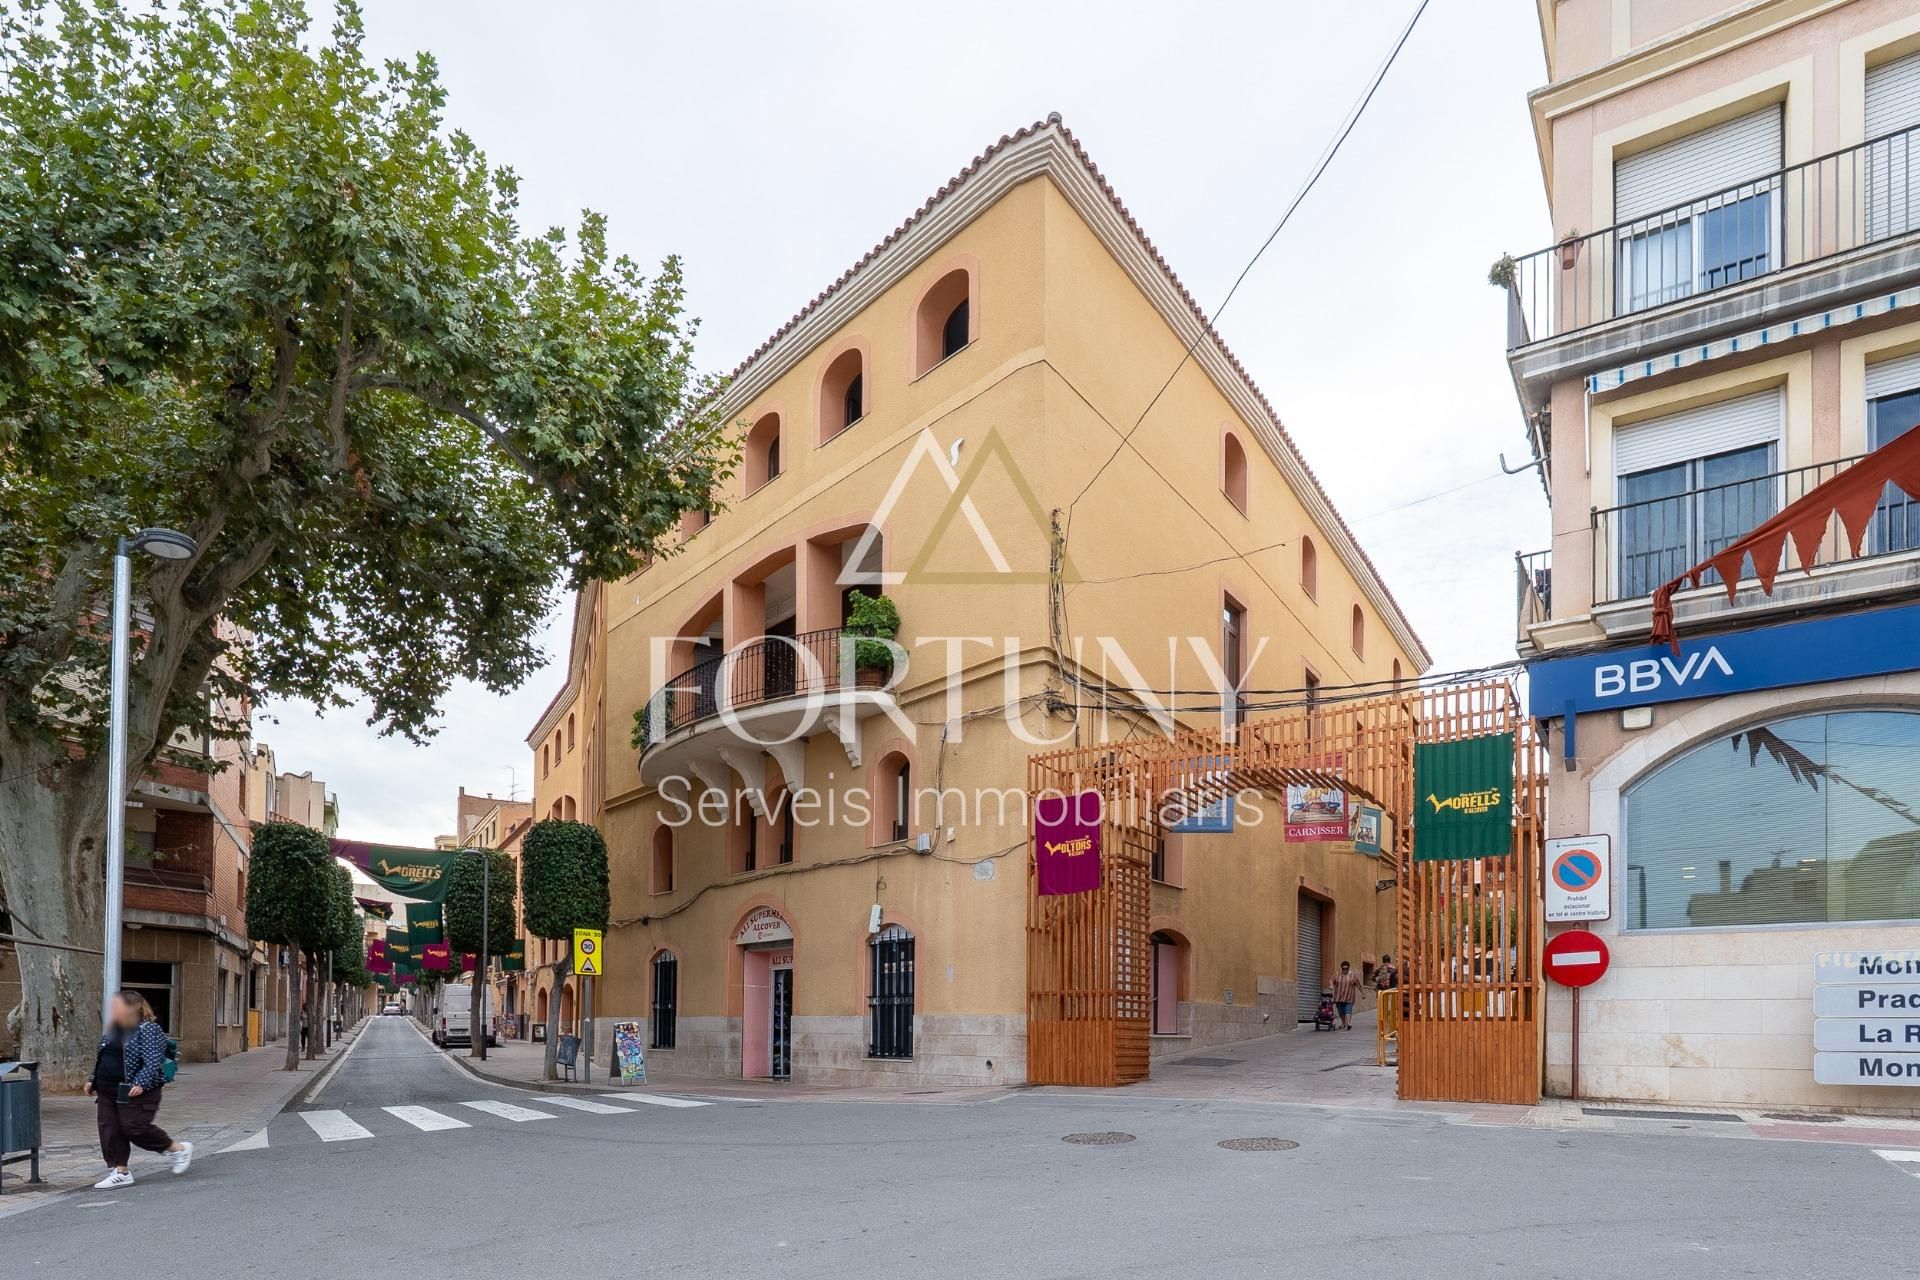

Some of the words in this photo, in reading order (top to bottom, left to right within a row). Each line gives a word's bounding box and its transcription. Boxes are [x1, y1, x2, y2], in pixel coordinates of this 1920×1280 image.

[1595, 645, 1734, 697] BBVA
[1288, 826, 1344, 837] CARNISSER
[753, 921, 781, 932] ALCOVER
[1859, 1024, 1892, 1043] La
